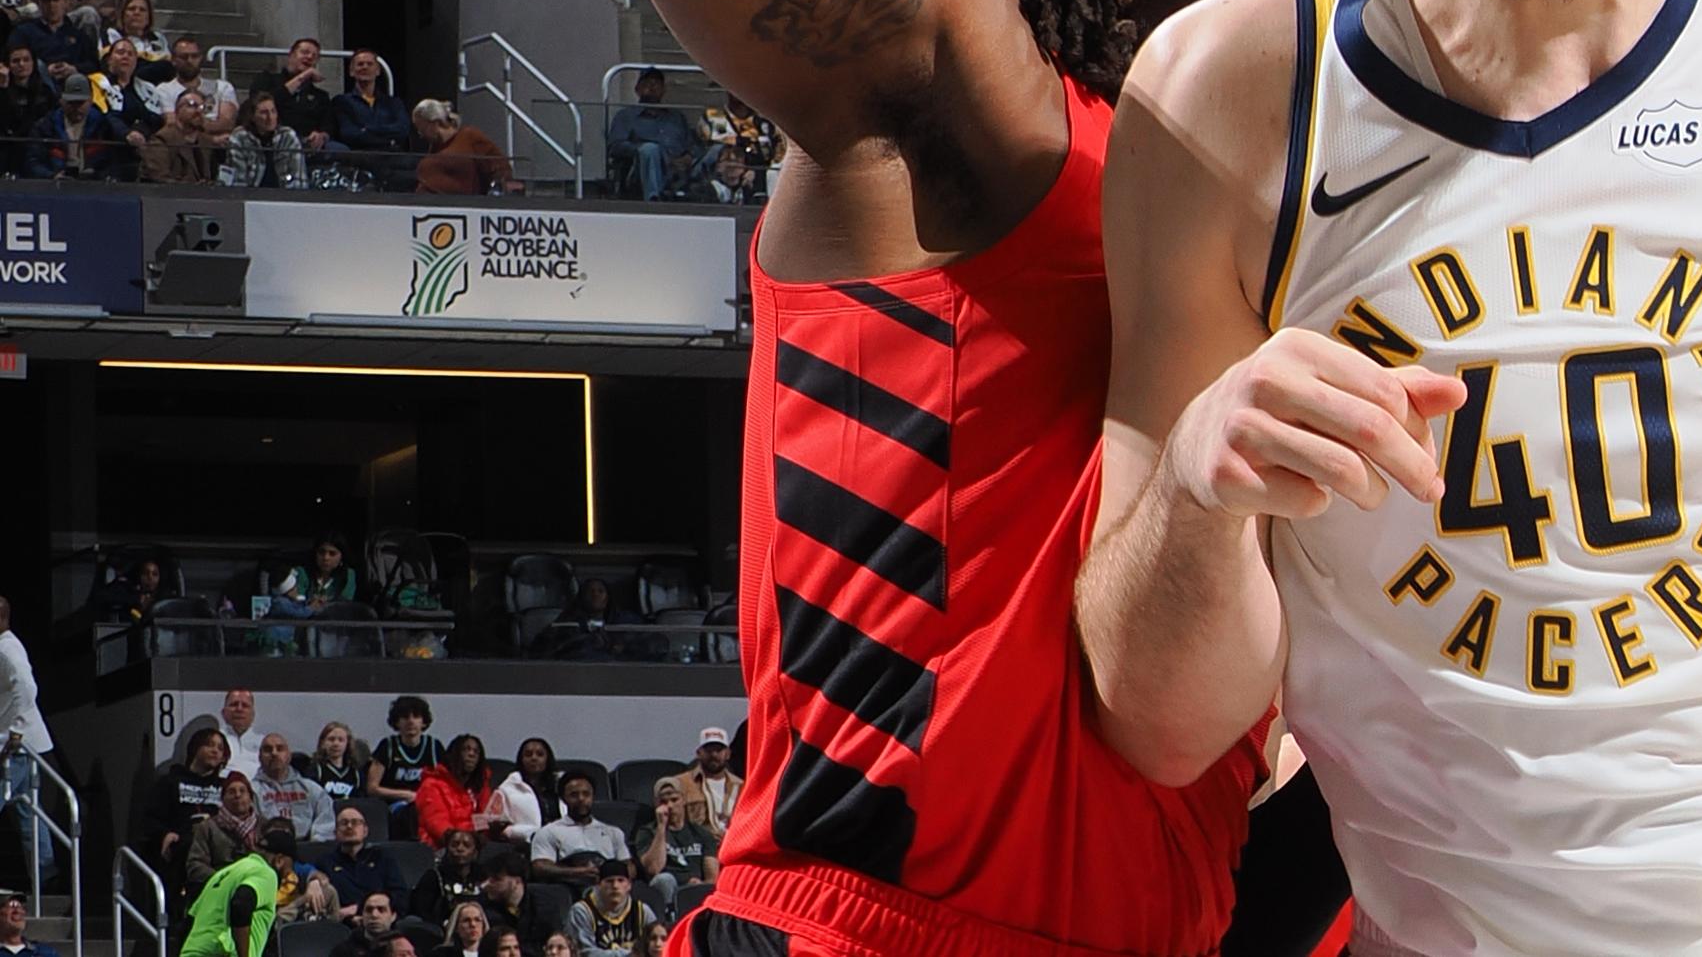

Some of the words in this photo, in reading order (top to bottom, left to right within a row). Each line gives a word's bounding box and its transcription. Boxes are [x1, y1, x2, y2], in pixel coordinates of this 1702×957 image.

[1618, 121, 1699, 149] LUCAS
[0, 213, 68, 252] EL
[480, 215, 570, 238] INDIANA
[480, 236, 578, 259] SOYBEAN
[481, 257, 579, 280] ALLIANCE
[1433, 343, 1687, 570] 40
[158, 692, 174, 737] 8
